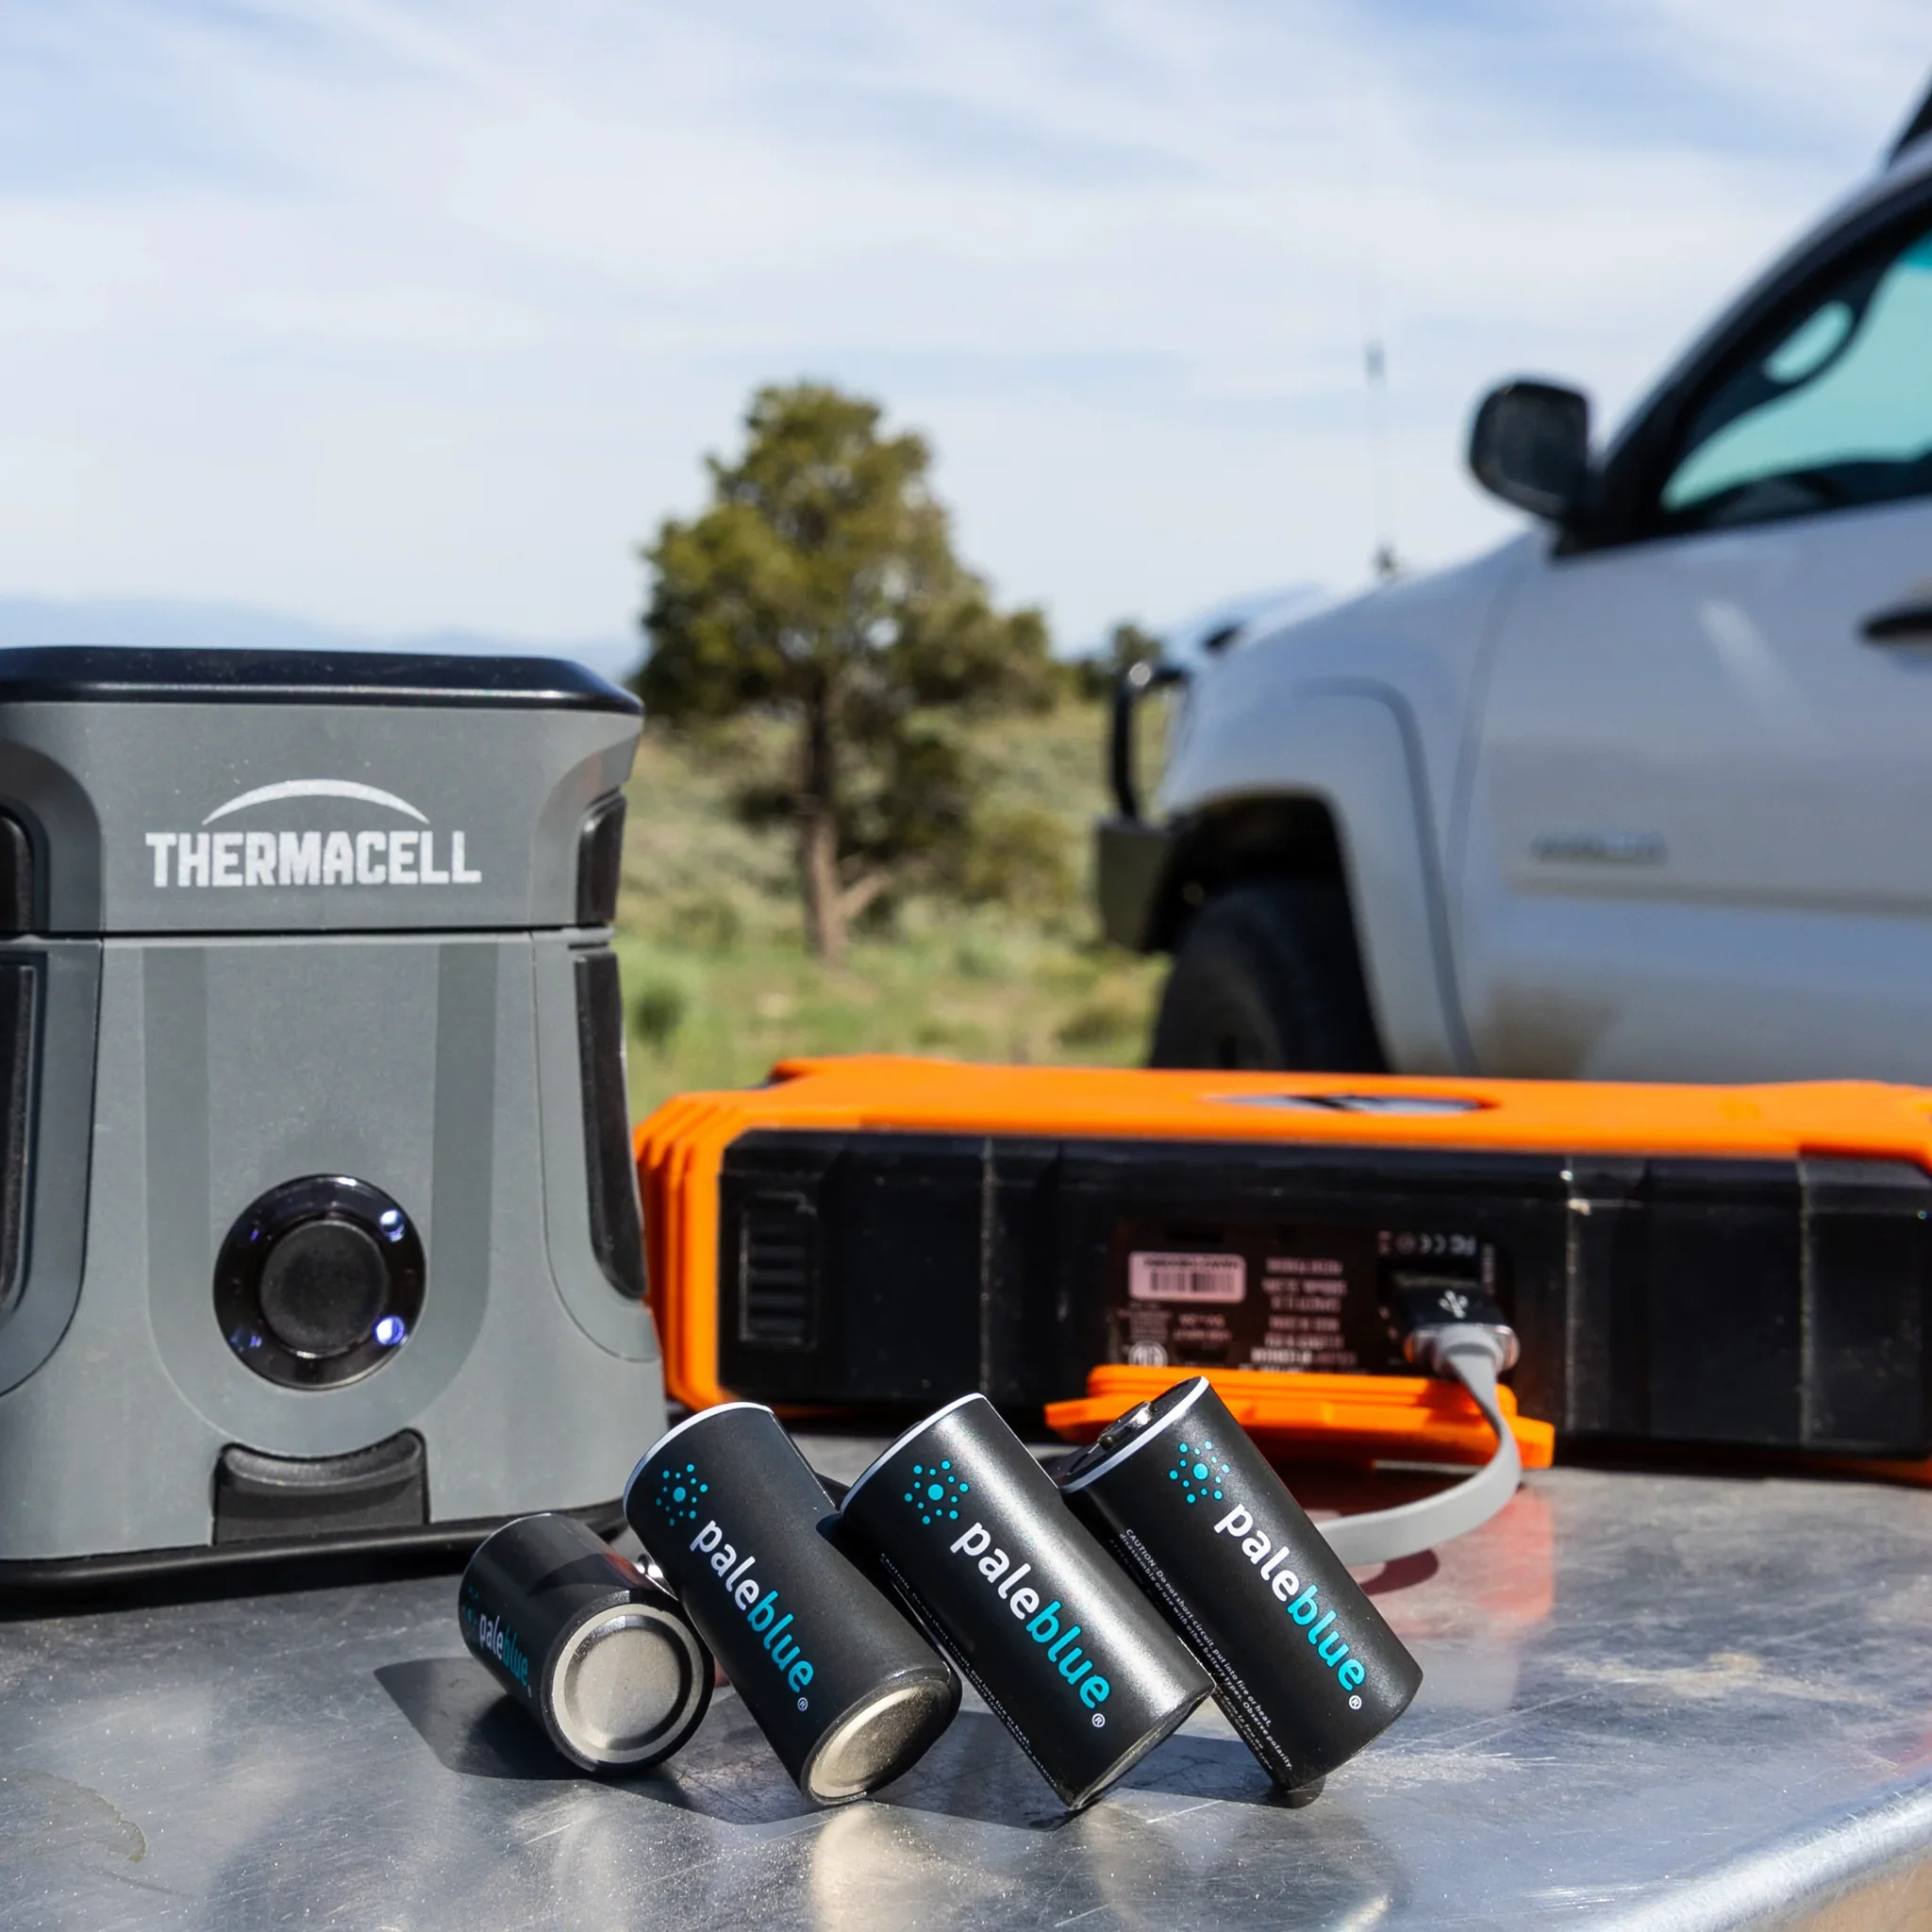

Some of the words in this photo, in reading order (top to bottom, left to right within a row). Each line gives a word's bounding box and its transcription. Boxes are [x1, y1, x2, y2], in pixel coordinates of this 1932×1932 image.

[145, 831, 482, 888] THERMACELL
[1119, 1533, 1156, 1581] disassemble
[1155, 1581, 1163, 1591] or
[1161, 1591, 1174, 1605] use
[1173, 1606, 1187, 1624] with
[1186, 1624, 1204, 1646] other
[479, 1613, 528, 1687] paleblue
[1164, 1582, 1177, 1597] not
[1211, 1648, 1225, 1663] put
[1224, 1662, 1238, 1679] into
[1236, 1679, 1248, 1694] fire
[1247, 1695, 1257, 1704] or
[1255, 1704, 1271, 1726] heat,
